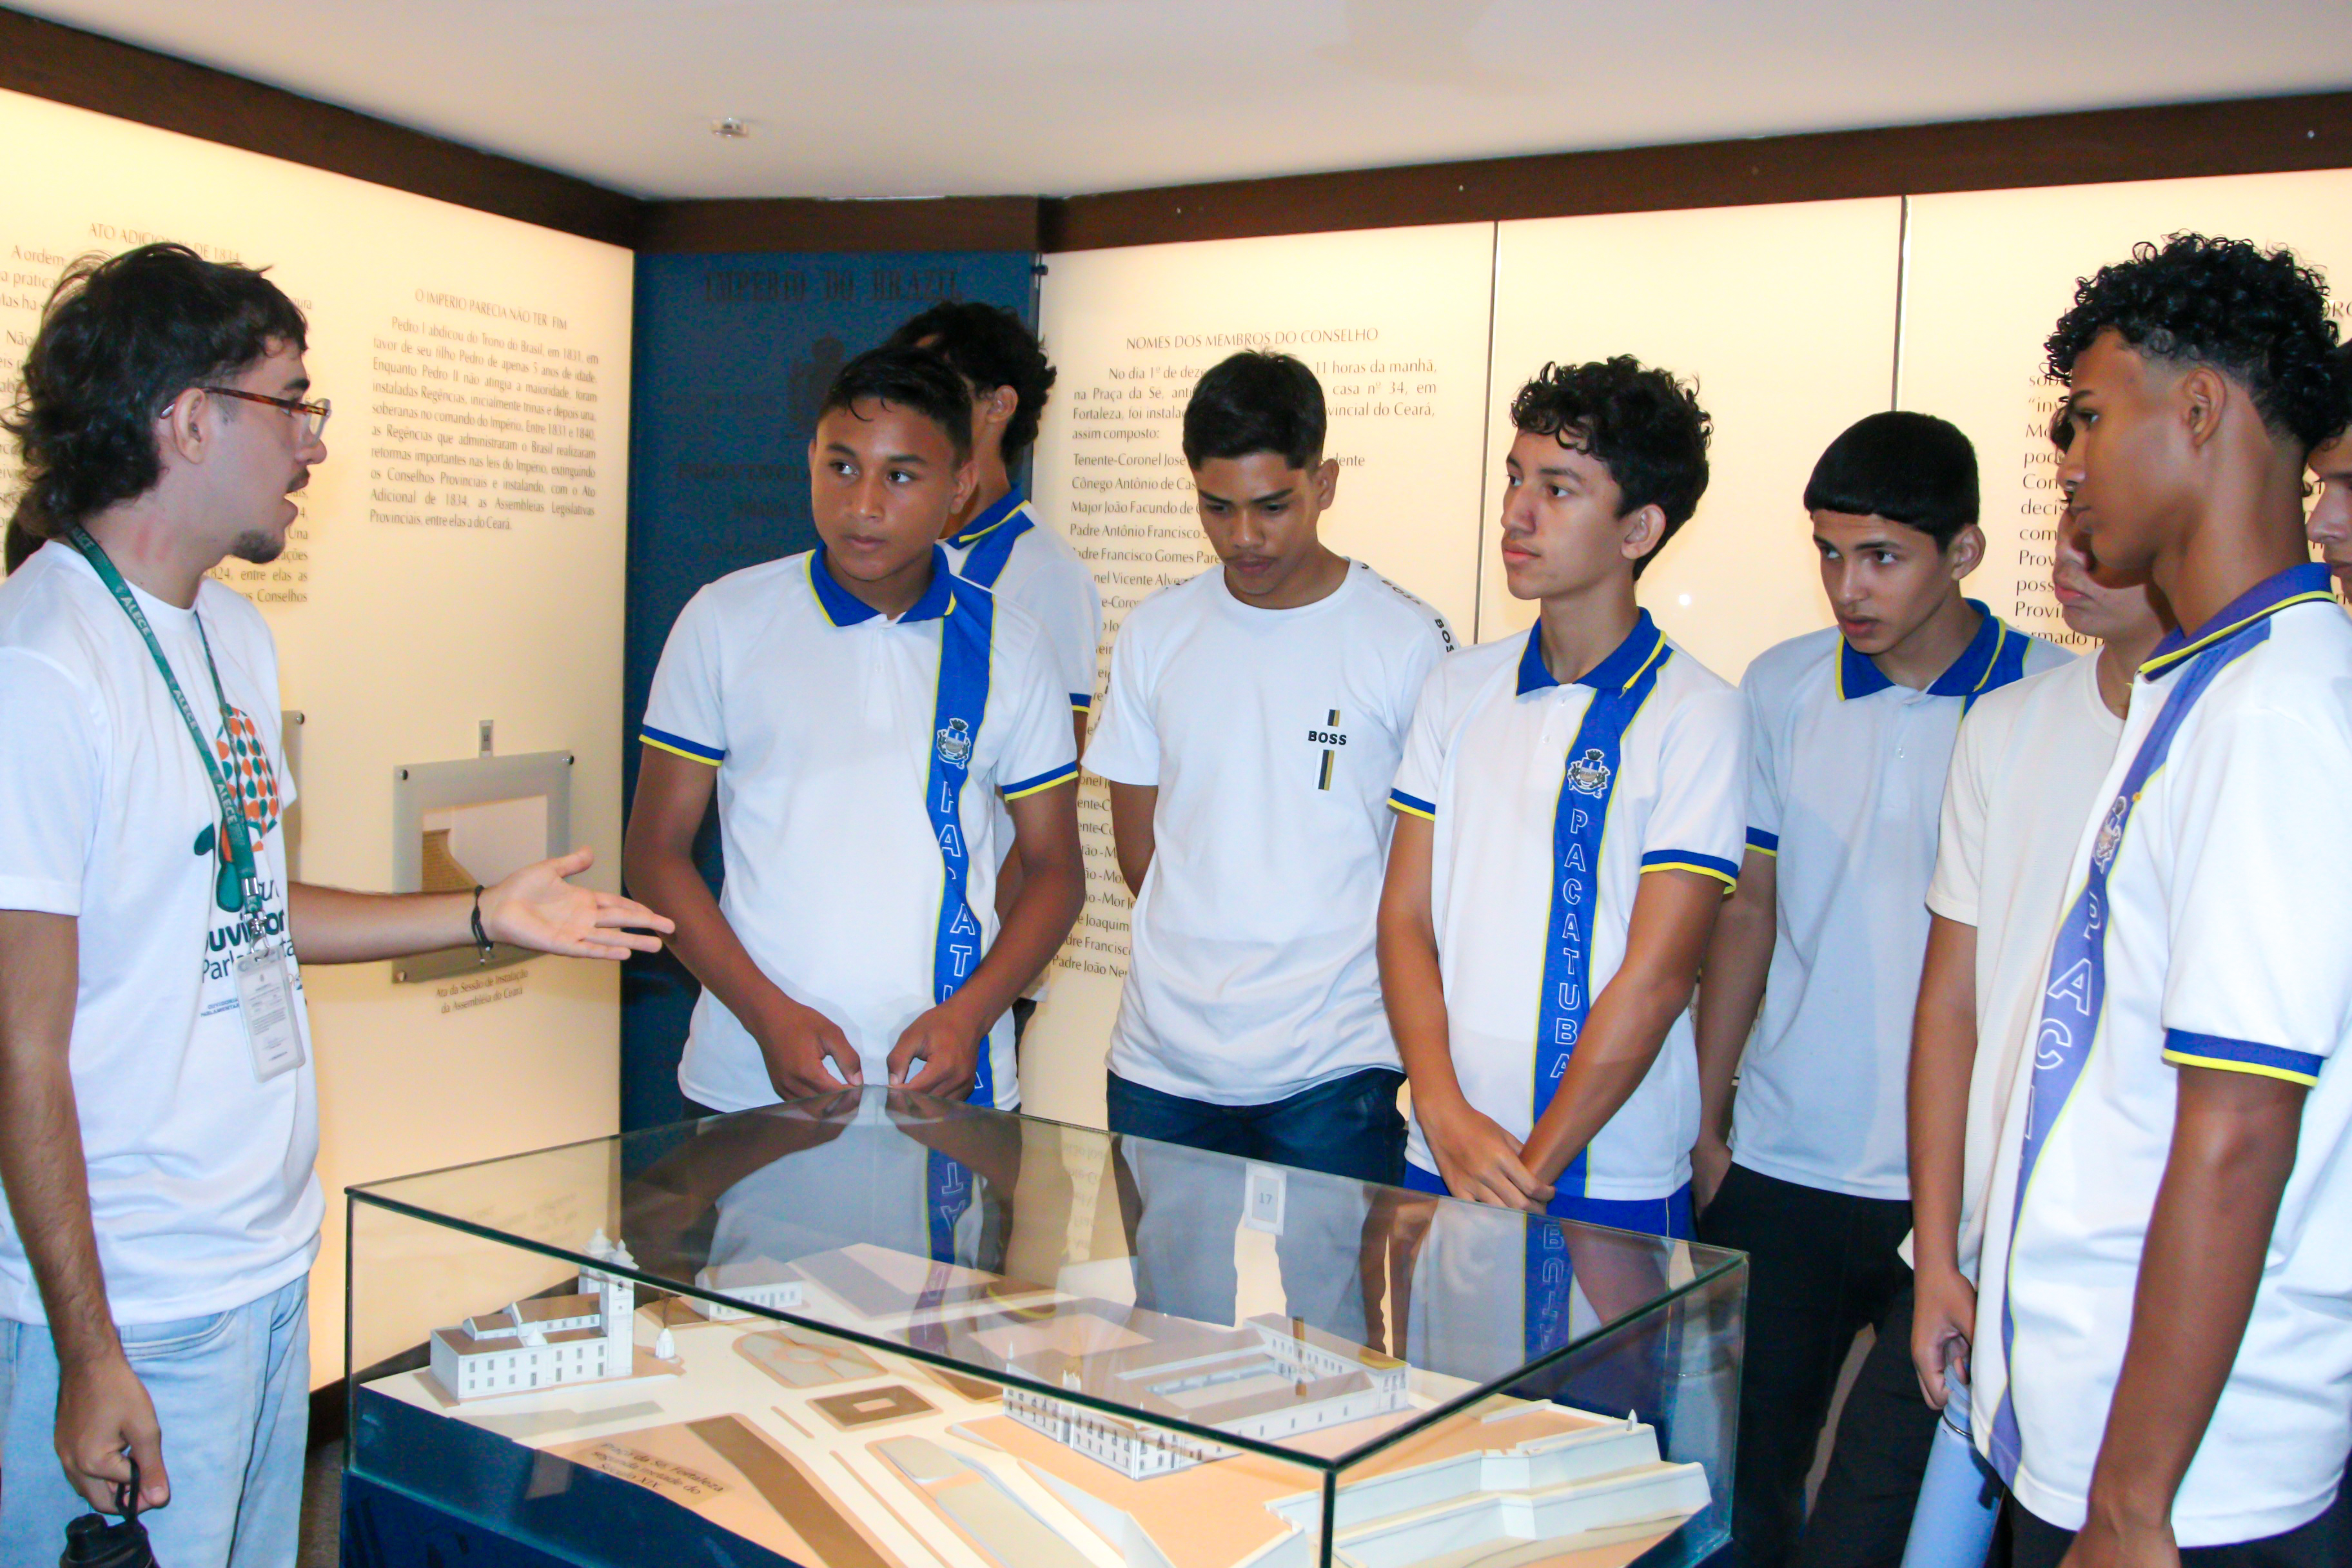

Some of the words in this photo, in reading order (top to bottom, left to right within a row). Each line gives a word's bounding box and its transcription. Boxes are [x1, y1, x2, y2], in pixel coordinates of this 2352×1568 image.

[415, 288, 424, 302] O
[469, 299, 507, 319] PARECIA
[533, 311, 547, 326] TER
[553, 316, 567, 330] FIM
[1126, 335, 1170, 349] NOMES
[1175, 334, 1201, 348] DOS
[1205, 331, 1270, 347] MEMBROS
[1275, 330, 1297, 344] DO
[1300, 328, 1378, 344] CONSELHO
[1109, 368, 1124, 380] No
[1128, 366, 1145, 379] dia
[1163, 365, 1177, 378] de
[1333, 360, 1366, 374] horas
[1370, 359, 1385, 373] da
[1389, 358, 1437, 373] manhã,
[1074, 390, 1086, 400] na
[1093, 387, 1122, 402] Praça
[1129, 387, 1142, 399] da
[1333, 384, 1359, 395] casa
[1388, 381, 1407, 395] 34,
[1416, 383, 1436, 393] em
[1073, 406, 1124, 420] Fortaleza,
[1128, 406, 1142, 419] foi
[1374, 402, 1389, 416] do
[1394, 402, 1435, 416] Ceará,
[1072, 429, 1101, 440] assim
[1103, 427, 1159, 443] composto:
[1073, 453, 1161, 466] Tenente-Coronel
[1072, 476, 1113, 493] Cônego
[1115, 476, 1158, 490] Antônio
[1161, 476, 1174, 490] de
[1071, 501, 1102, 516] Major
[1104, 500, 1127, 514] João
[1130, 500, 1177, 514] Facundo
[1180, 501, 1193, 514] de
[1070, 524, 1099, 536] Padre
[1102, 525, 1144, 537] Antônio
[1148, 525, 1200, 538] Francisco
[1101, 548, 1152, 561] Francisco
[1155, 549, 1193, 563] Gomes
[1113, 572, 1152, 585] Vicente
[257, 588, 308, 602] Conselhos
[121, 596, 151, 637] ALECE
[1435, 618, 1455, 652] BOS
[1308, 730, 1347, 745] BOSS
[1086, 914, 1129, 932] Joaquim
[1550, 808, 1588, 1078] PACATUBA
[1052, 954, 1082, 970] Padre
[1084, 960, 1106, 975] João
[1259, 1192, 1272, 1205] 17
